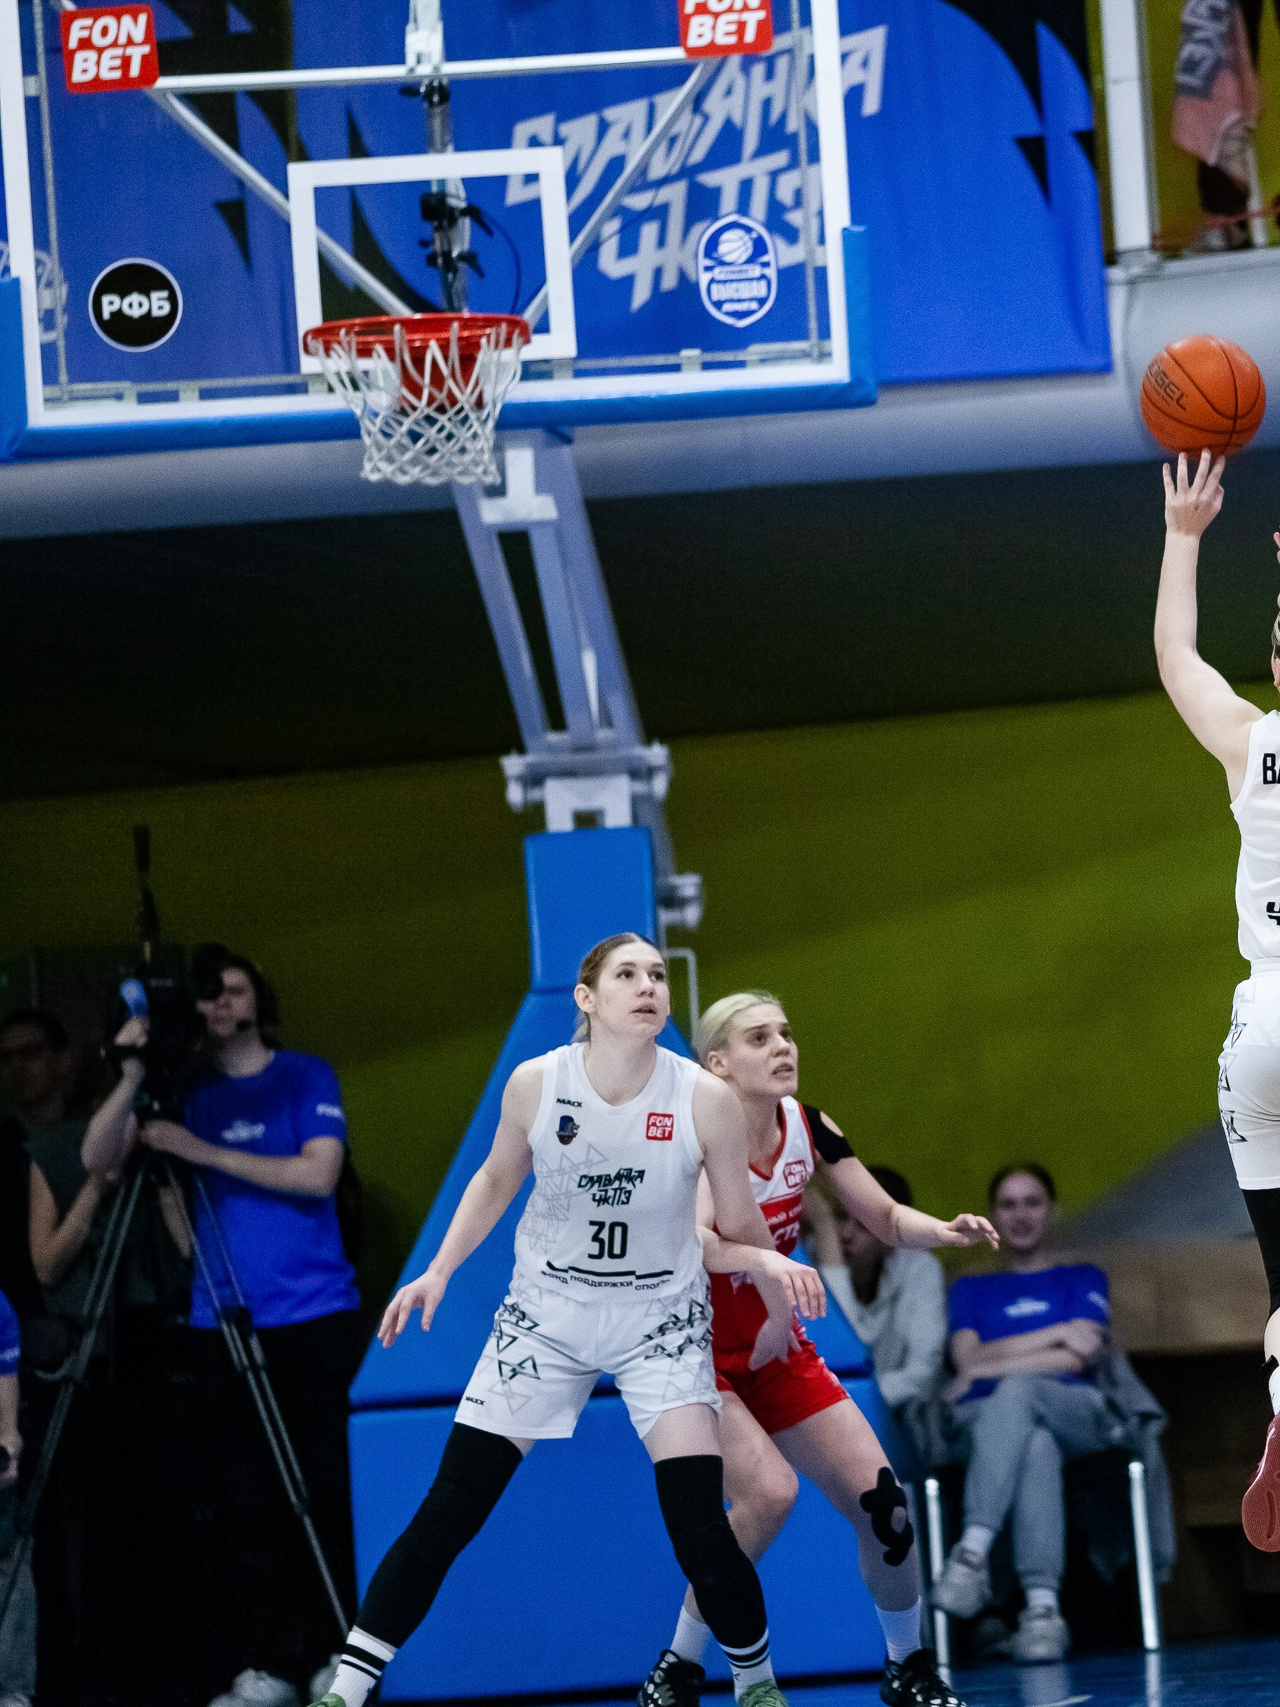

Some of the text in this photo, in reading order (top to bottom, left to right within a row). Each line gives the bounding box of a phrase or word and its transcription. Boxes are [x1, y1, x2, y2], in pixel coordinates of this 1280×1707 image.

[68, 11, 148, 50] FON
[686, 9, 767, 48] BET
[71, 44, 151, 83] BET
[101, 289, 171, 321] РФБ
[647, 1126, 671, 1138] BET
[648, 1115, 673, 1127] FON
[587, 1220, 629, 1260] 30
[570, 1275, 633, 1288] ПОДДЕРЖКИ
